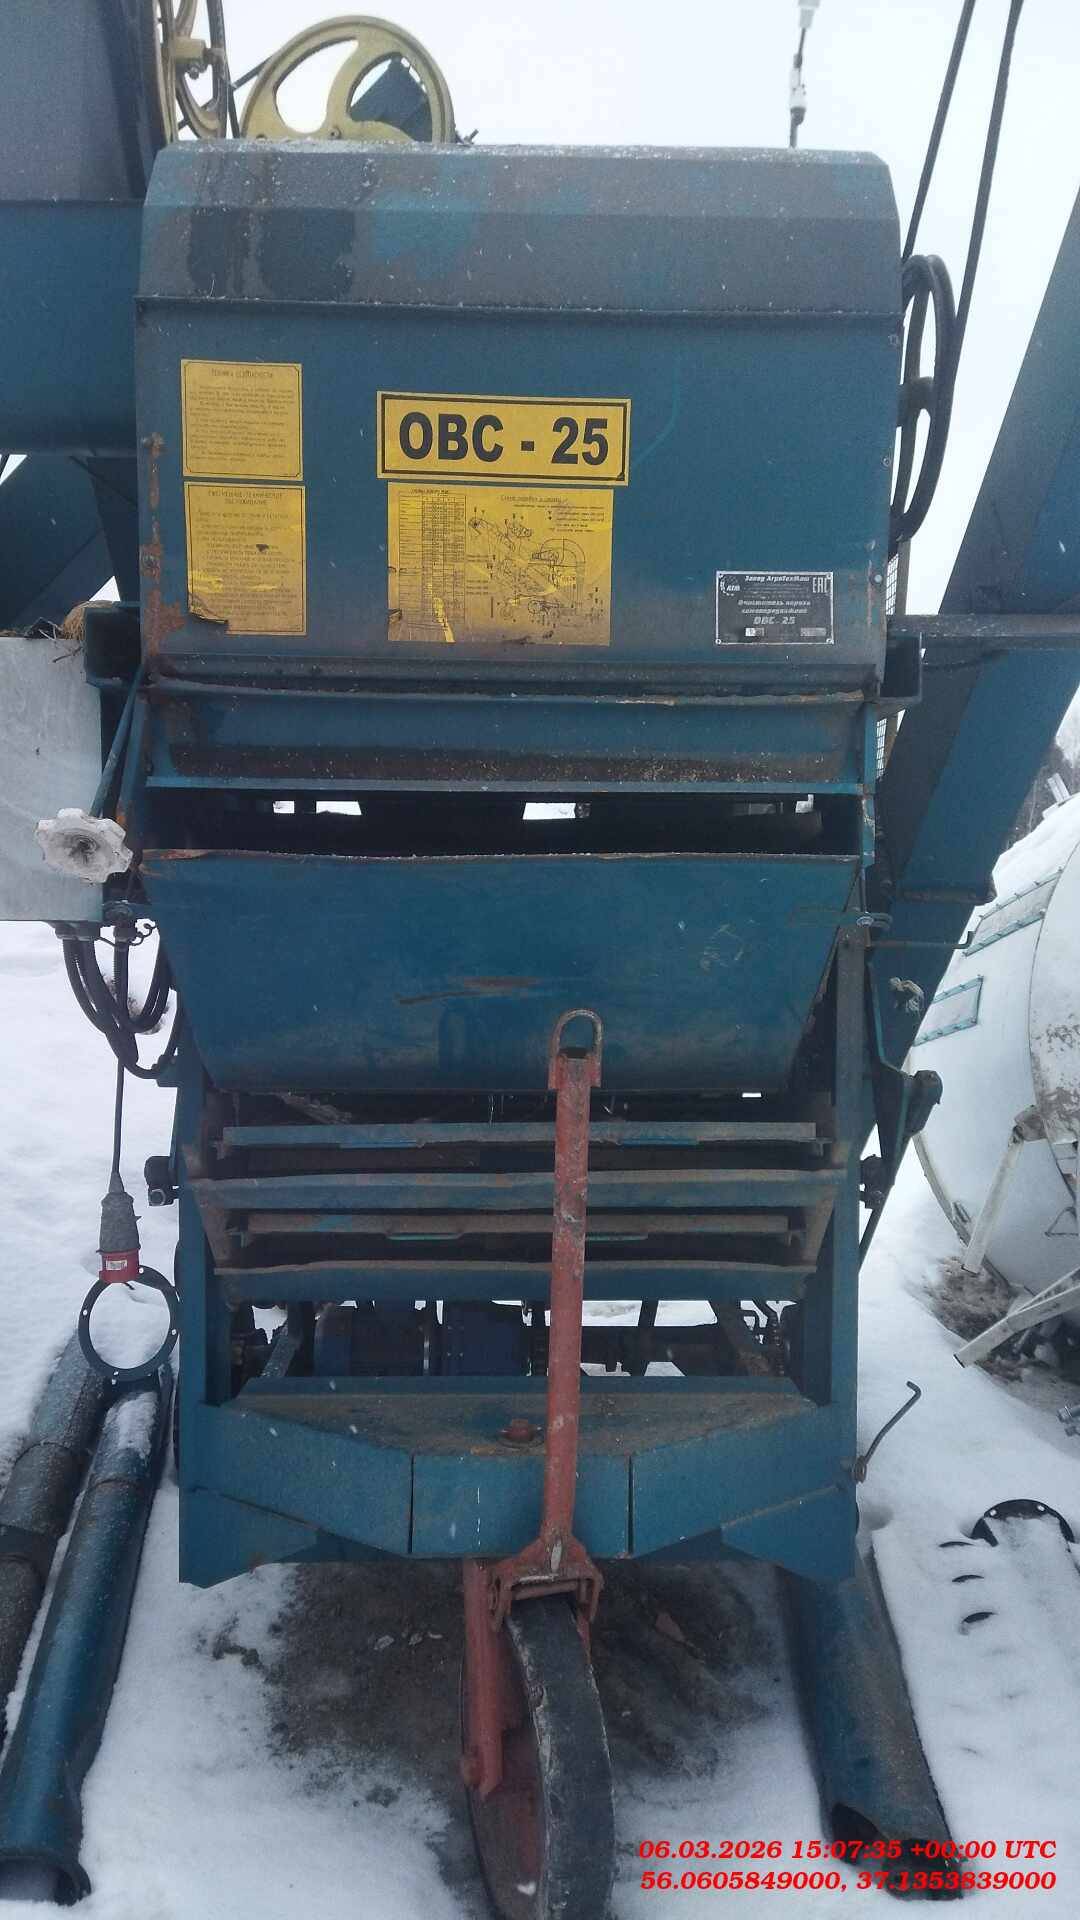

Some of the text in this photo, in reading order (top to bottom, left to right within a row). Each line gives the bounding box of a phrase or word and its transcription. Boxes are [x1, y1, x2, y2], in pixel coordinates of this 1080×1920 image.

[399, 411, 609, 466] ОВС - 25
